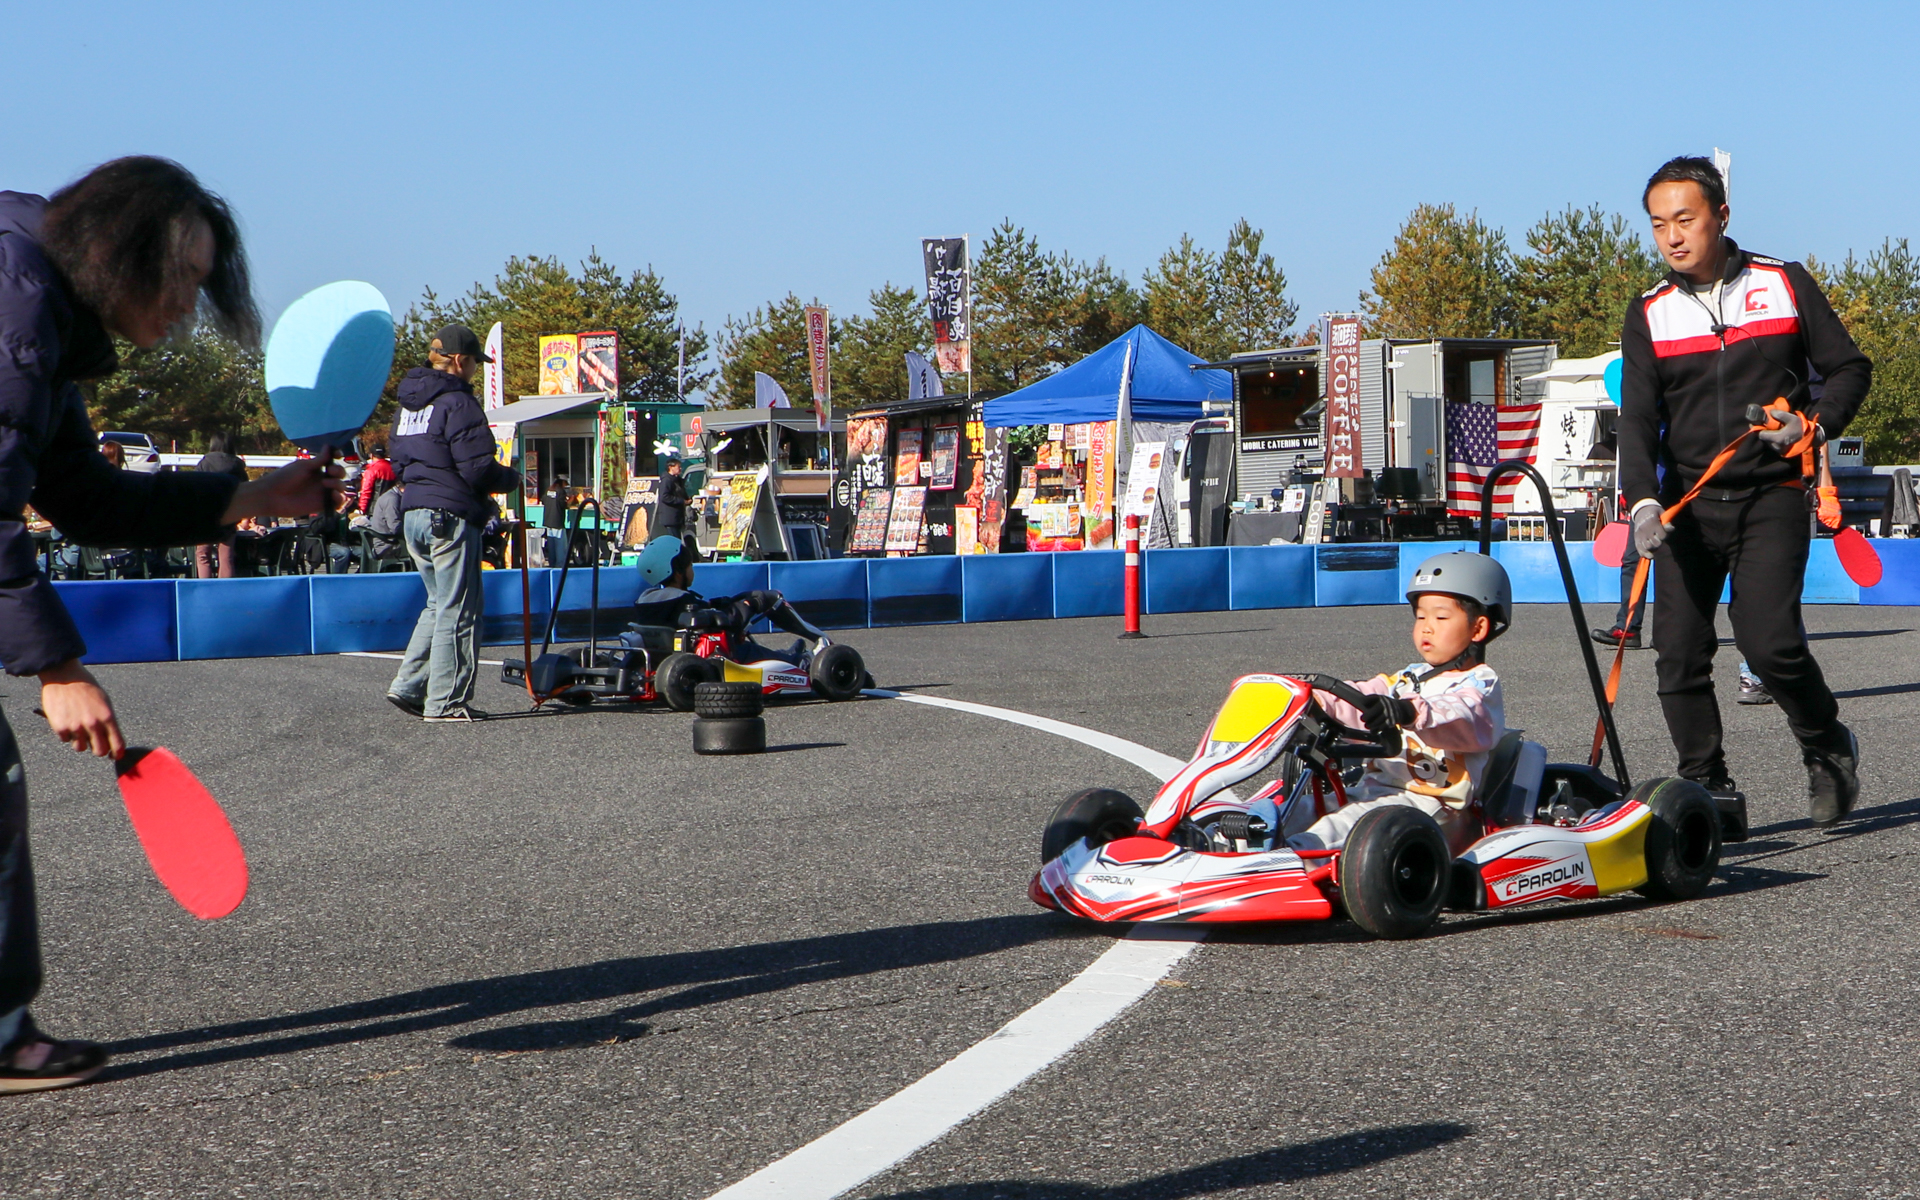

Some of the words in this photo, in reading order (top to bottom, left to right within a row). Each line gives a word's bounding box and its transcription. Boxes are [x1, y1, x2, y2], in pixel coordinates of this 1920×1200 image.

[1330, 354, 1354, 474] COFFEE
[1242, 440, 1266, 451] MOBILE
[1267, 439, 1301, 449] CATERING
[1302, 437, 1318, 447] VAN
[785, 510, 828, 520] キッチンカ
[1091, 875, 1136, 886] PAROLIN
[1518, 861, 1584, 893] PAROLIN
